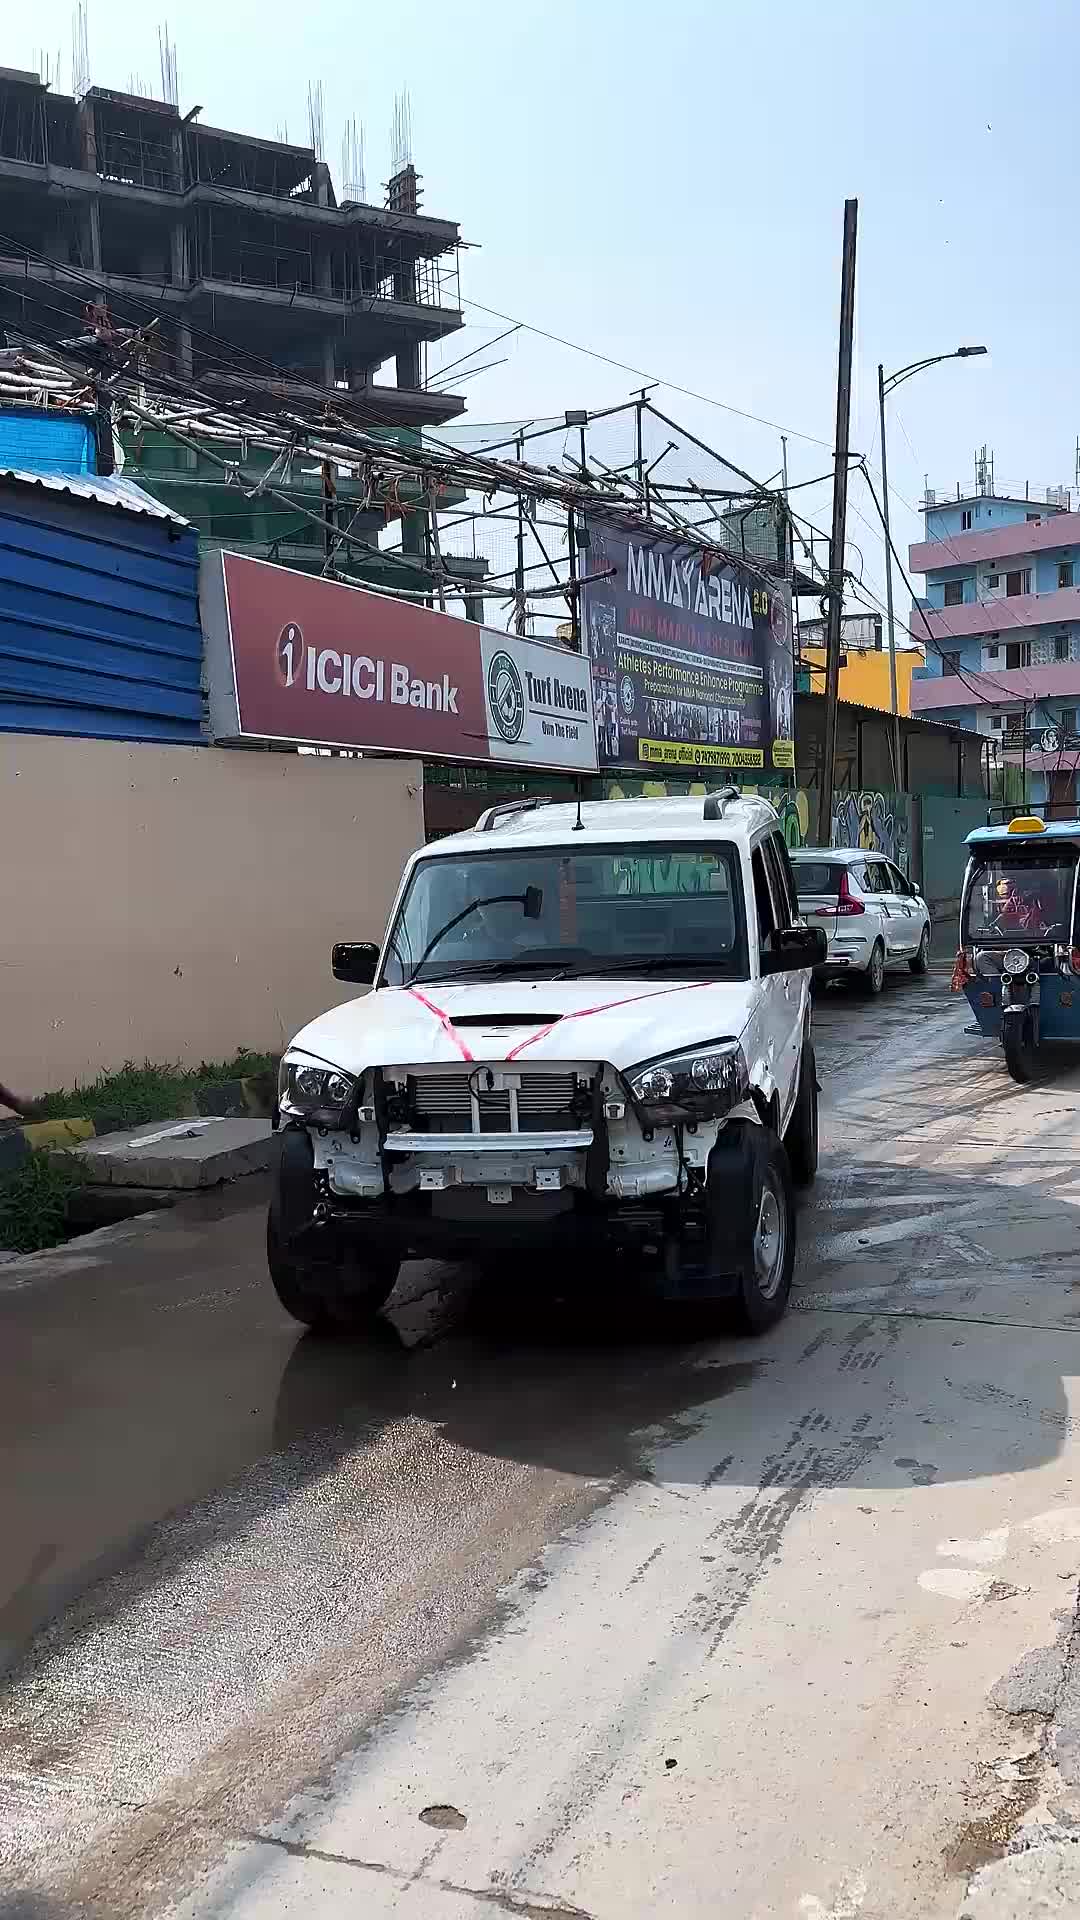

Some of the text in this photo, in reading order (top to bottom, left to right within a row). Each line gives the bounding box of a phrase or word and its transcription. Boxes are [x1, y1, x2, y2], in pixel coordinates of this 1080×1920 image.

[752, 588, 769, 617] 2.0
[306, 646, 384, 701] ICICI
[390, 663, 460, 714] Bank
[525, 671, 552, 706] Turf
[553, 678, 588, 713] Arena
[617, 652, 652, 675] Athletes
[652, 660, 700, 685] Performance
[700, 671, 729, 691] Enhance
[728, 677, 764, 699] Programme
[541, 720, 579, 740] Own The Field
